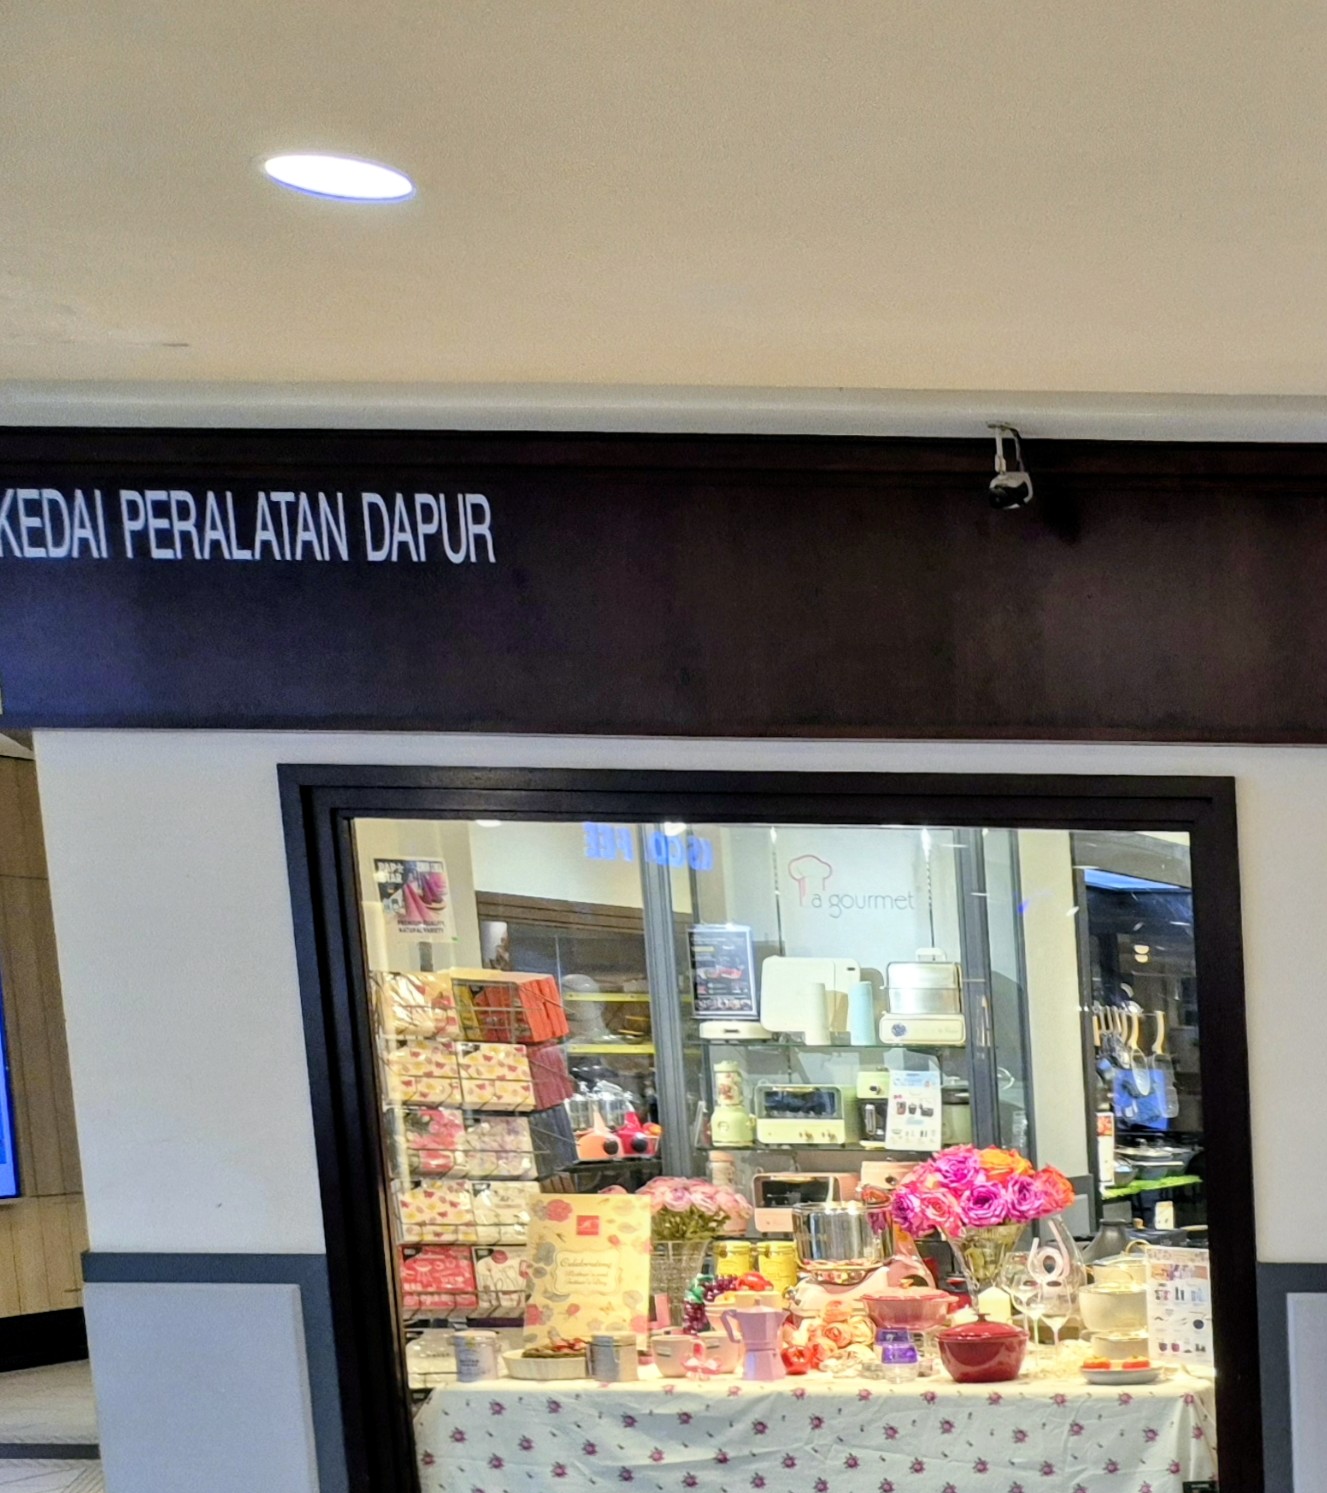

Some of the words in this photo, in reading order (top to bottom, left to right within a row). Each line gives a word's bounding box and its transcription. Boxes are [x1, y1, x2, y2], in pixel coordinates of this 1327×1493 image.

[0, 487, 108, 560] KEDAI
[122, 489, 351, 563] PERALATAN
[363, 492, 497, 564] DAPUR
[828, 890, 916, 918] gourmet
